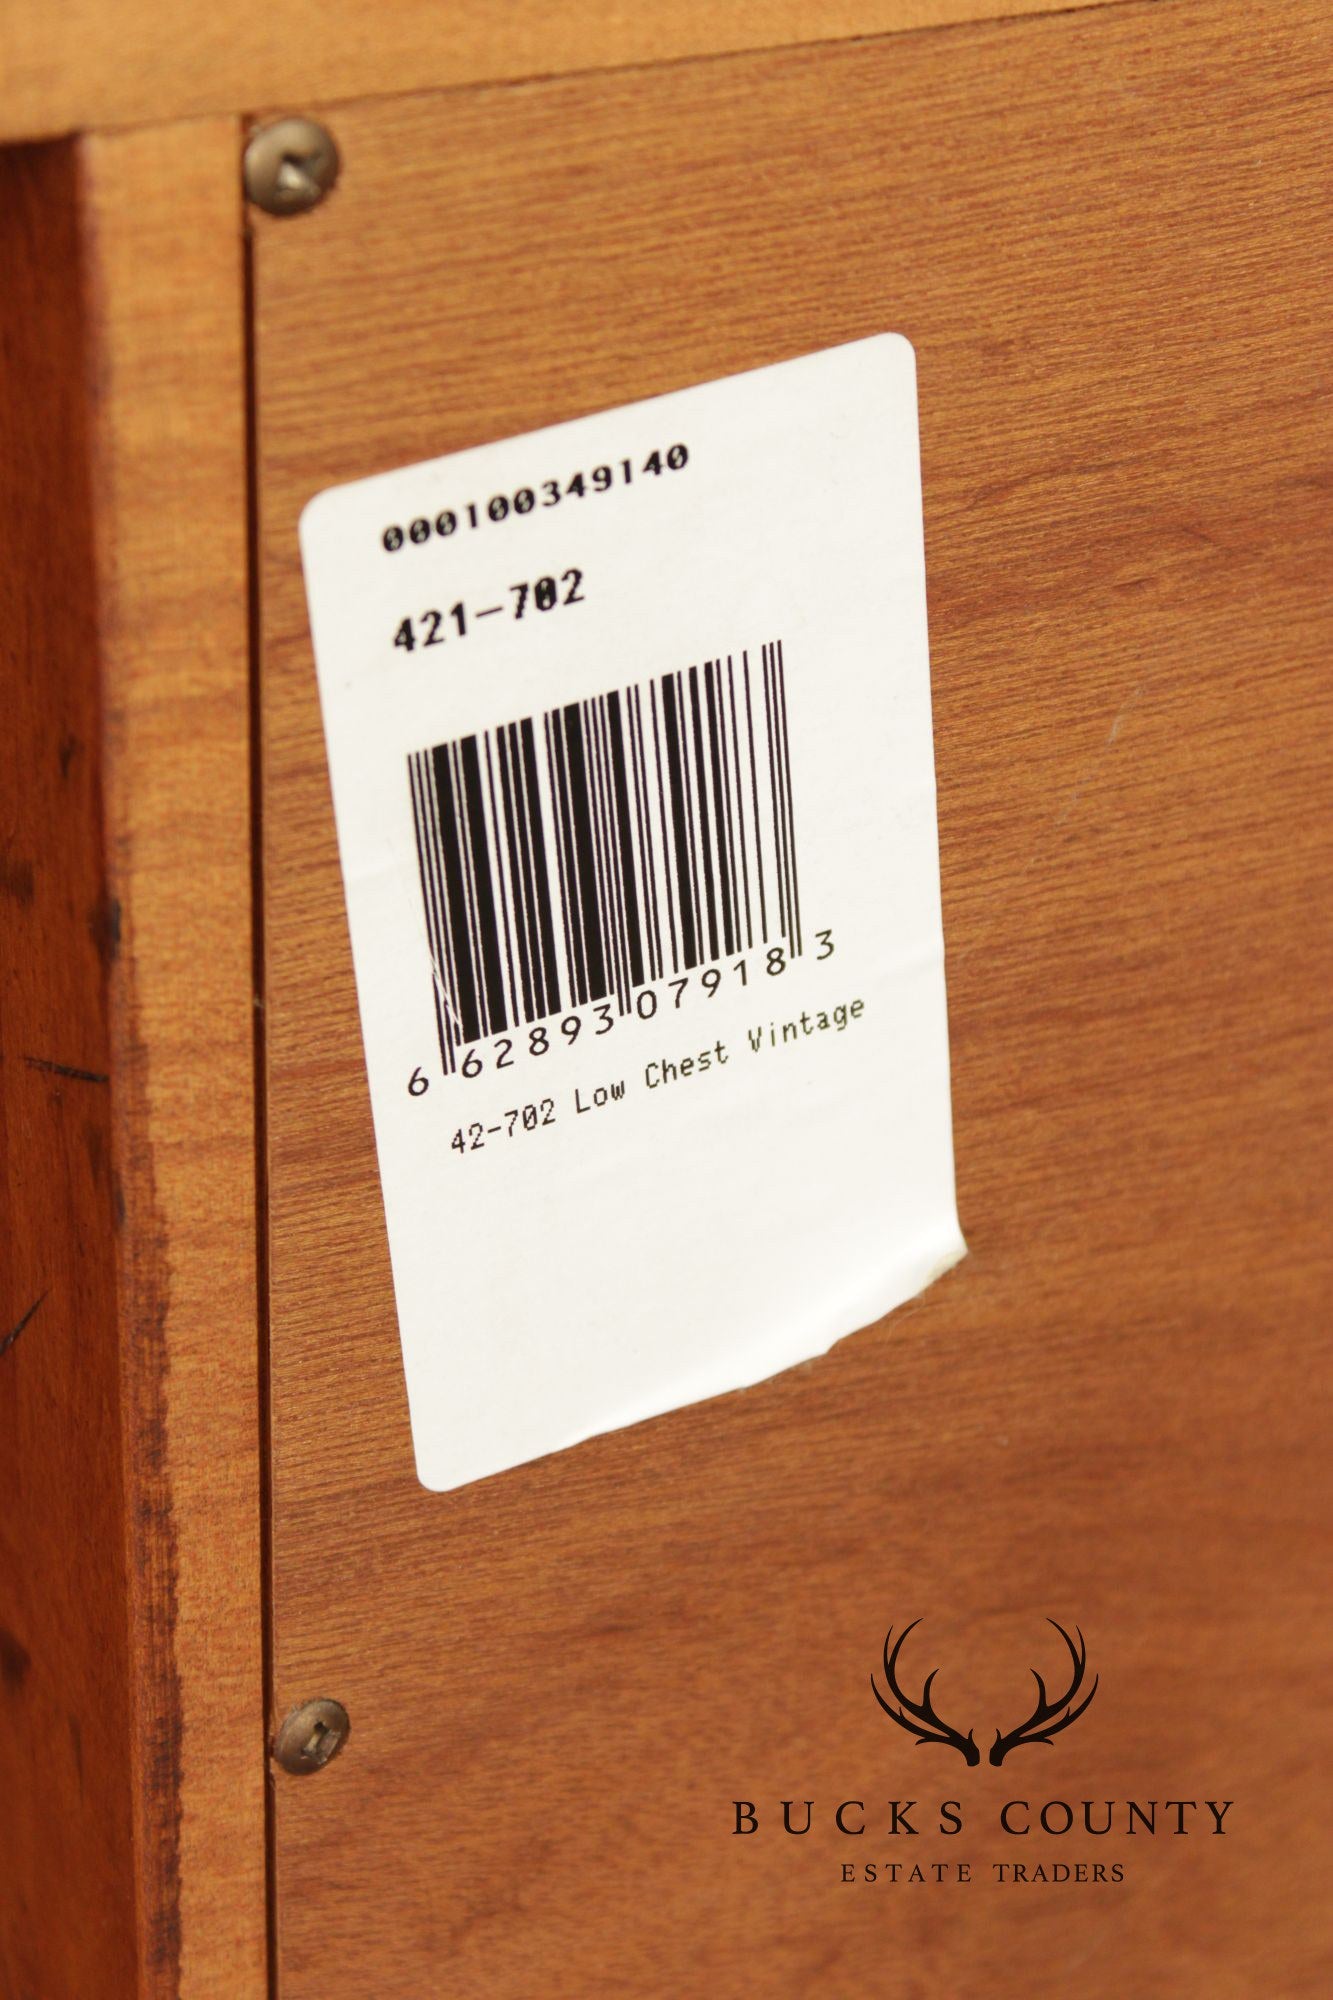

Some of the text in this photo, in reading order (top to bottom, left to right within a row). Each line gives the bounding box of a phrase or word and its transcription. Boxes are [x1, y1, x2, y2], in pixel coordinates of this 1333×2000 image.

[381, 443, 690, 554] 000100349140
[392, 567, 586, 653] 421-702
[406, 928, 835, 1098] 6 62893 07918 3
[450, 998, 866, 1155] 42-702 Low Chest Vintage
